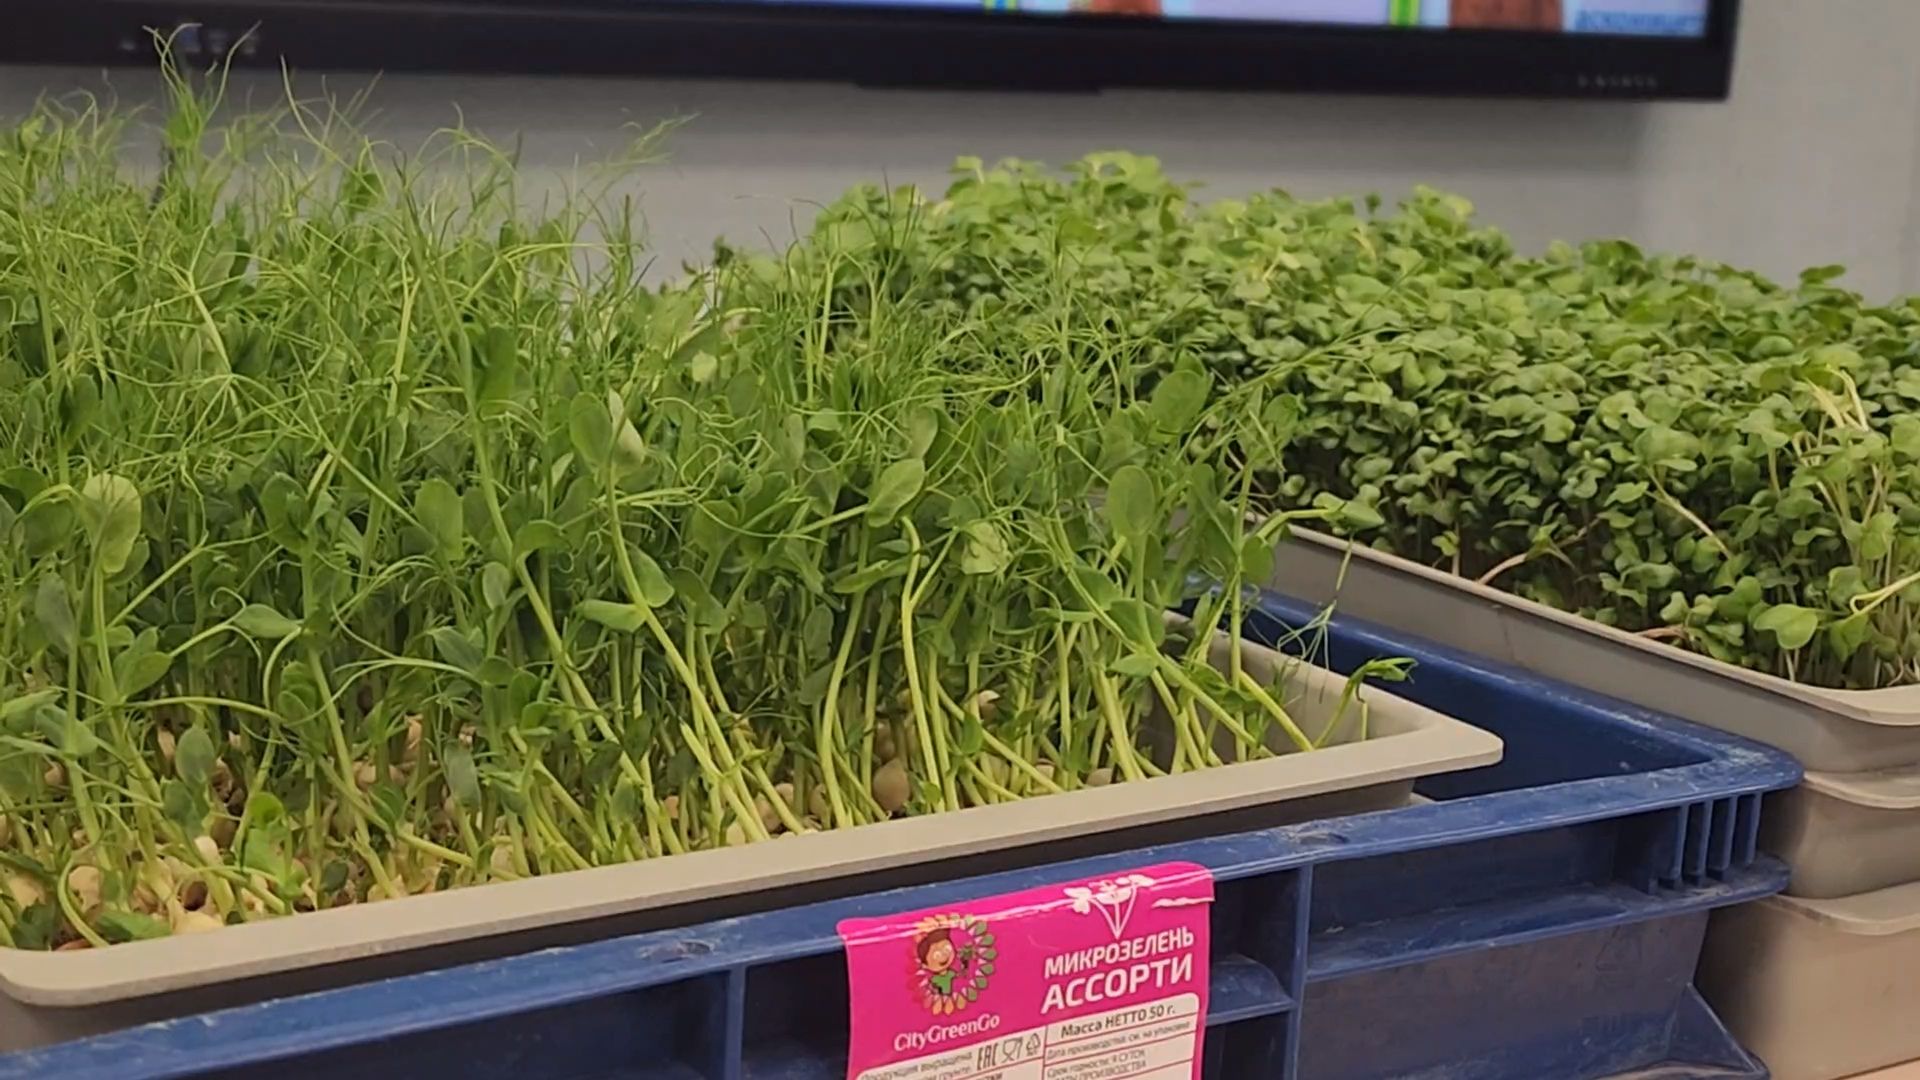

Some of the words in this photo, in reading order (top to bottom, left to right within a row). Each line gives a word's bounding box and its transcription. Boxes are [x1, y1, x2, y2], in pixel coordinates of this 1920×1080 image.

[1044, 926, 1194, 979] МИКРОЗЕЛЕНЬ
[1040, 953, 1192, 1014] АССОРТИ
[894, 1013, 1000, 1051] CityGreenGo
[1061, 1020, 1103, 1038] Масса
[1105, 1009, 1147, 1029] НЕТТО
[1148, 1004, 1164, 1020] 50
[1166, 1004, 1176, 1015] г.
